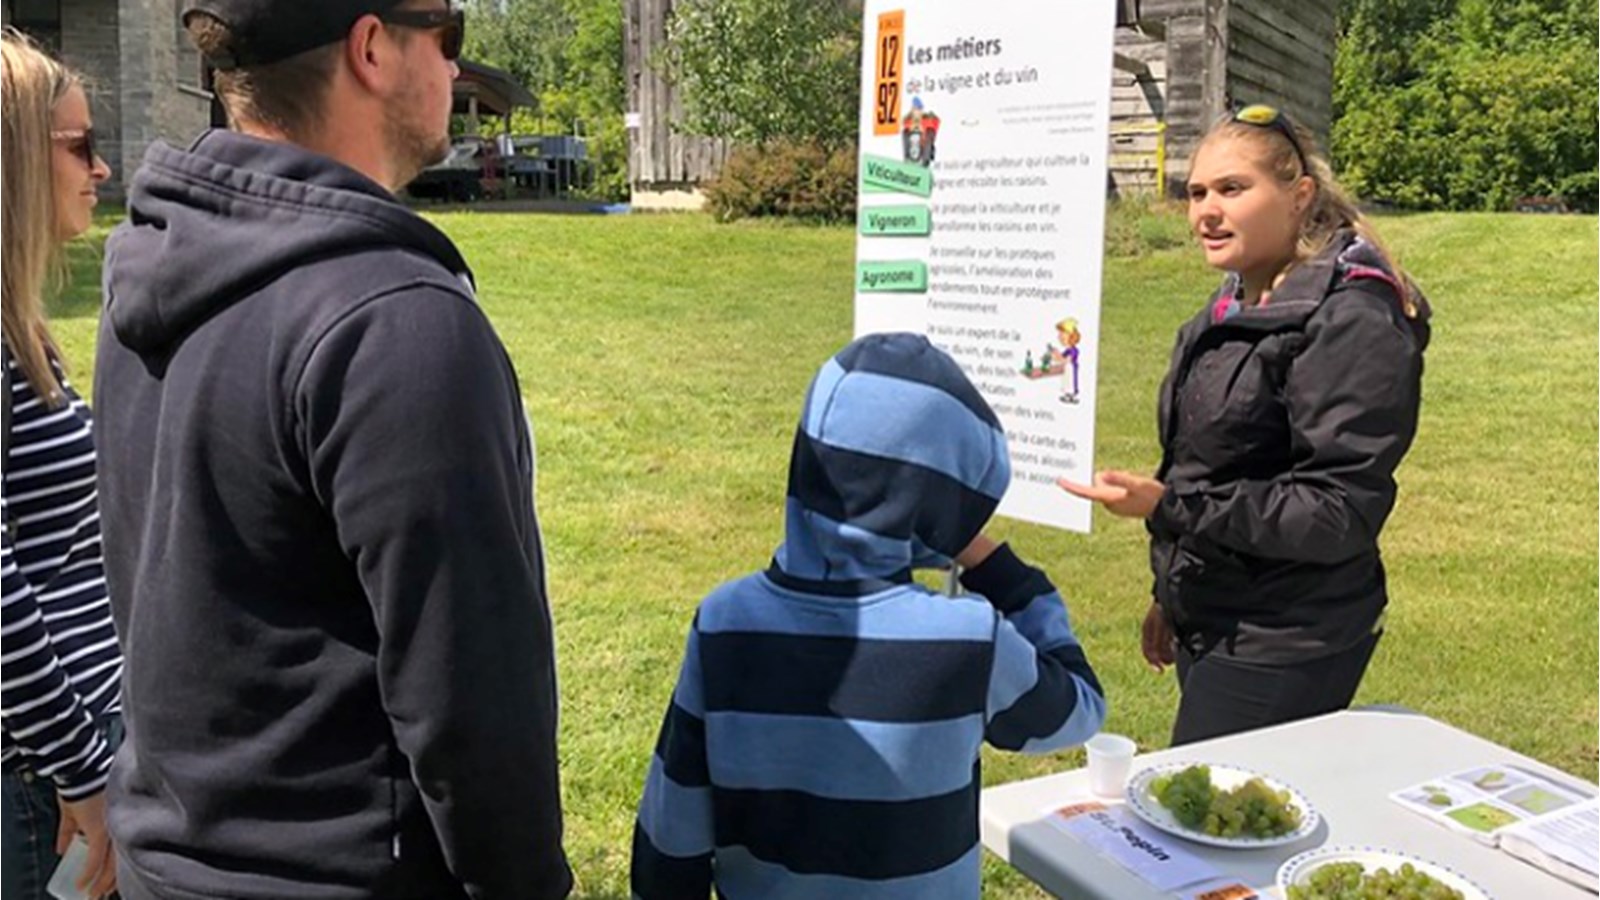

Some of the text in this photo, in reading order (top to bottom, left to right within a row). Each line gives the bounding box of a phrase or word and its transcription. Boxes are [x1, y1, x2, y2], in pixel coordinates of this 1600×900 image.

[881, 35, 899, 78] 12
[907, 36, 1002, 65] Les métiers
[906, 66, 1038, 94] de la vigne et du vin
[877, 82, 898, 124] 92
[975, 156, 1023, 171] agriculteur
[1026, 156, 1041, 168] qui
[1043, 154, 1077, 167] cultive
[1079, 152, 1090, 165] la
[867, 162, 922, 187] Viticulteur
[956, 177, 965, 188] et
[1001, 175, 1013, 187] les
[942, 202, 977, 215] pratique
[979, 201, 988, 213] la
[990, 202, 1036, 214] viticulture
[1038, 203, 1050, 214] et
[1051, 203, 1061, 217] je
[868, 214, 917, 231] Vigneron
[932, 221, 976, 232] ransforme
[978, 221, 992, 232] les
[993, 222, 1022, 232] raisins
[1024, 222, 1037, 232] en
[930, 247, 1055, 262] Je conseille sur les pratiques
[862, 271, 915, 287] Agronome
[1035, 267, 1053, 279] des
[980, 284, 1000, 295] tout
[1001, 286, 1014, 295] en
[967, 327, 997, 340] expert
[998, 329, 1010, 340] de
[1012, 329, 1021, 342] la
[952, 344, 963, 355] du
[983, 346, 995, 358] de
[977, 364, 993, 376] des
[1015, 405, 1032, 417] des
[1019, 430, 1029, 443] la
[1030, 434, 1056, 447] carte
[1058, 437, 1077, 451] des
